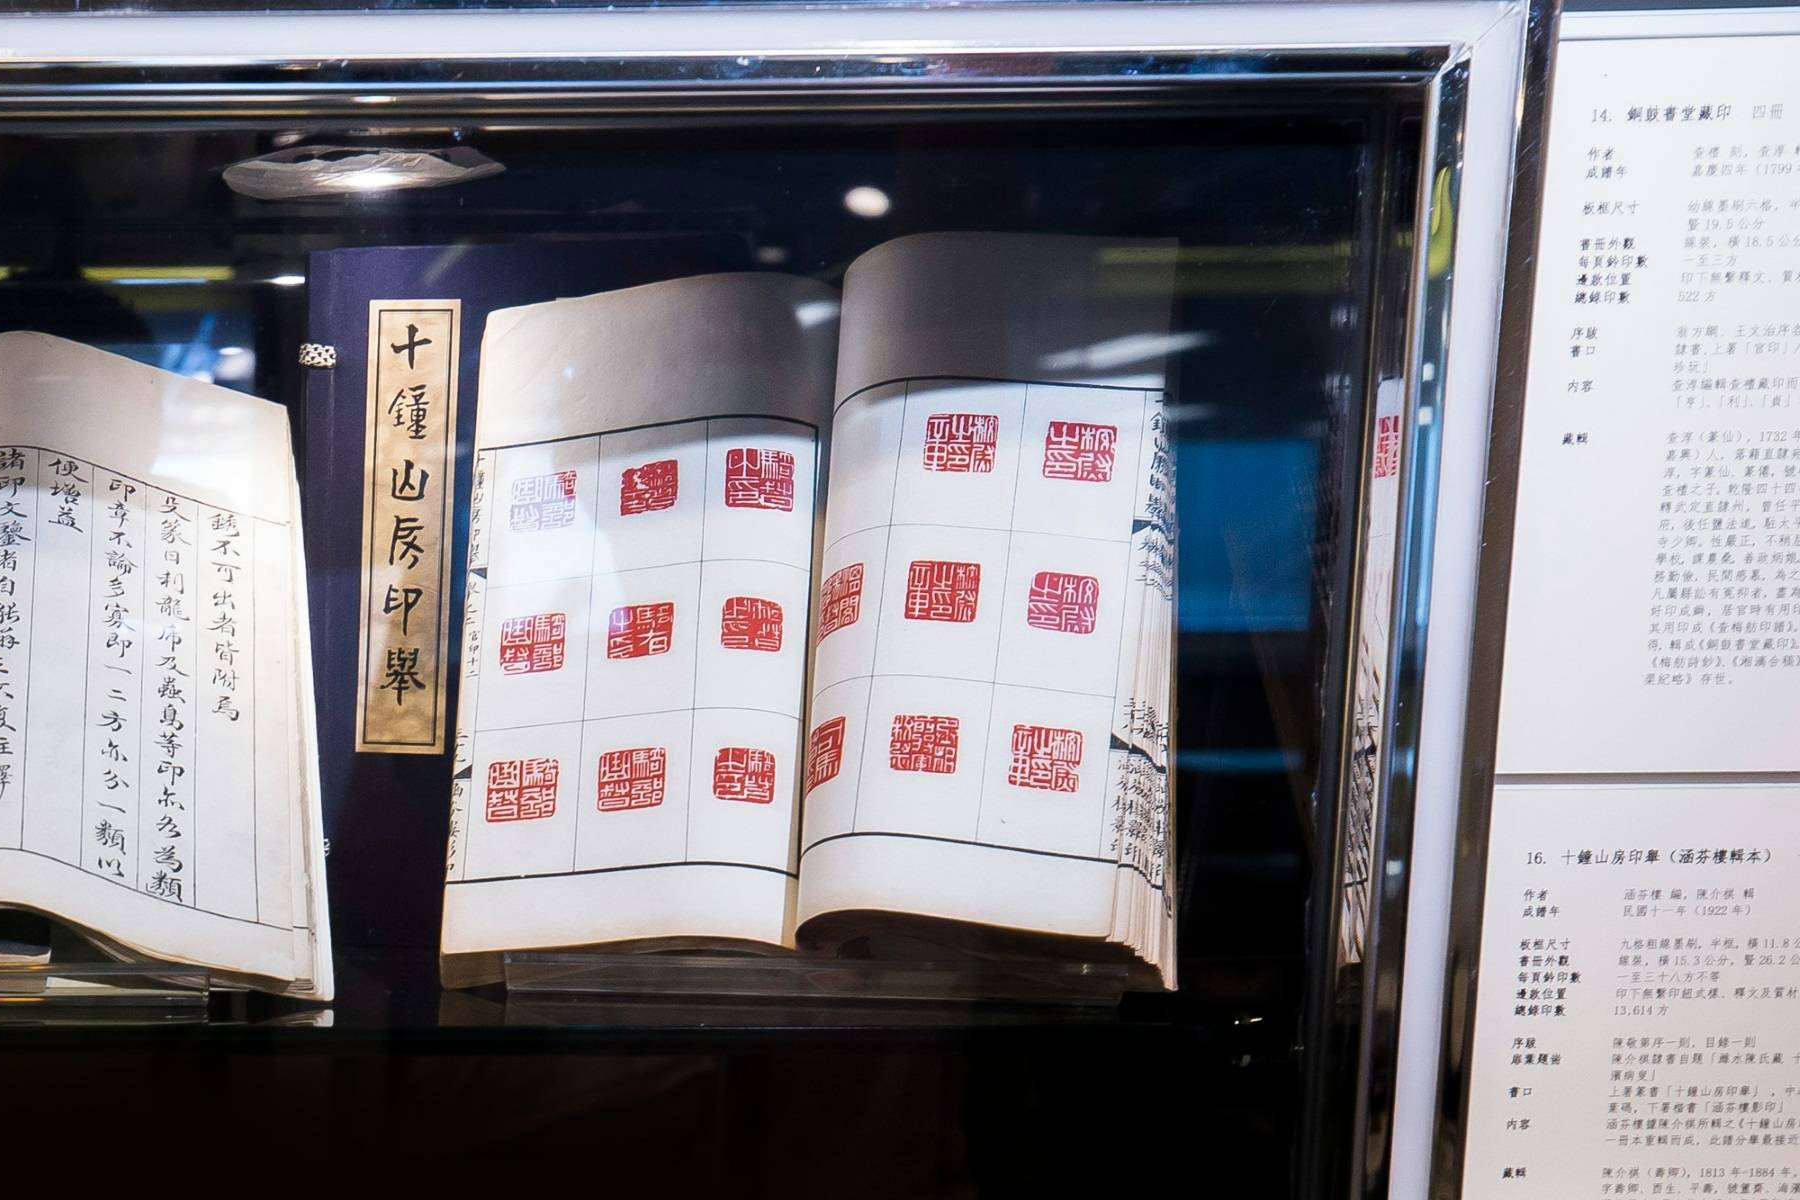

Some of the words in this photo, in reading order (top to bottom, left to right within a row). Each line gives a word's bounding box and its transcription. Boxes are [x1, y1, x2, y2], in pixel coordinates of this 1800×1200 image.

[1591, 109, 1613, 123] 14.
[1586, 147, 1616, 161] 作者
[1526, 850, 1548, 866] 16.
[1522, 888, 1549, 902] 作者
[1521, 905, 1561, 919] 成譜年
[1519, 937, 1572, 951] 板框尺寸
[1508, 1085, 1534, 1098] 書口
